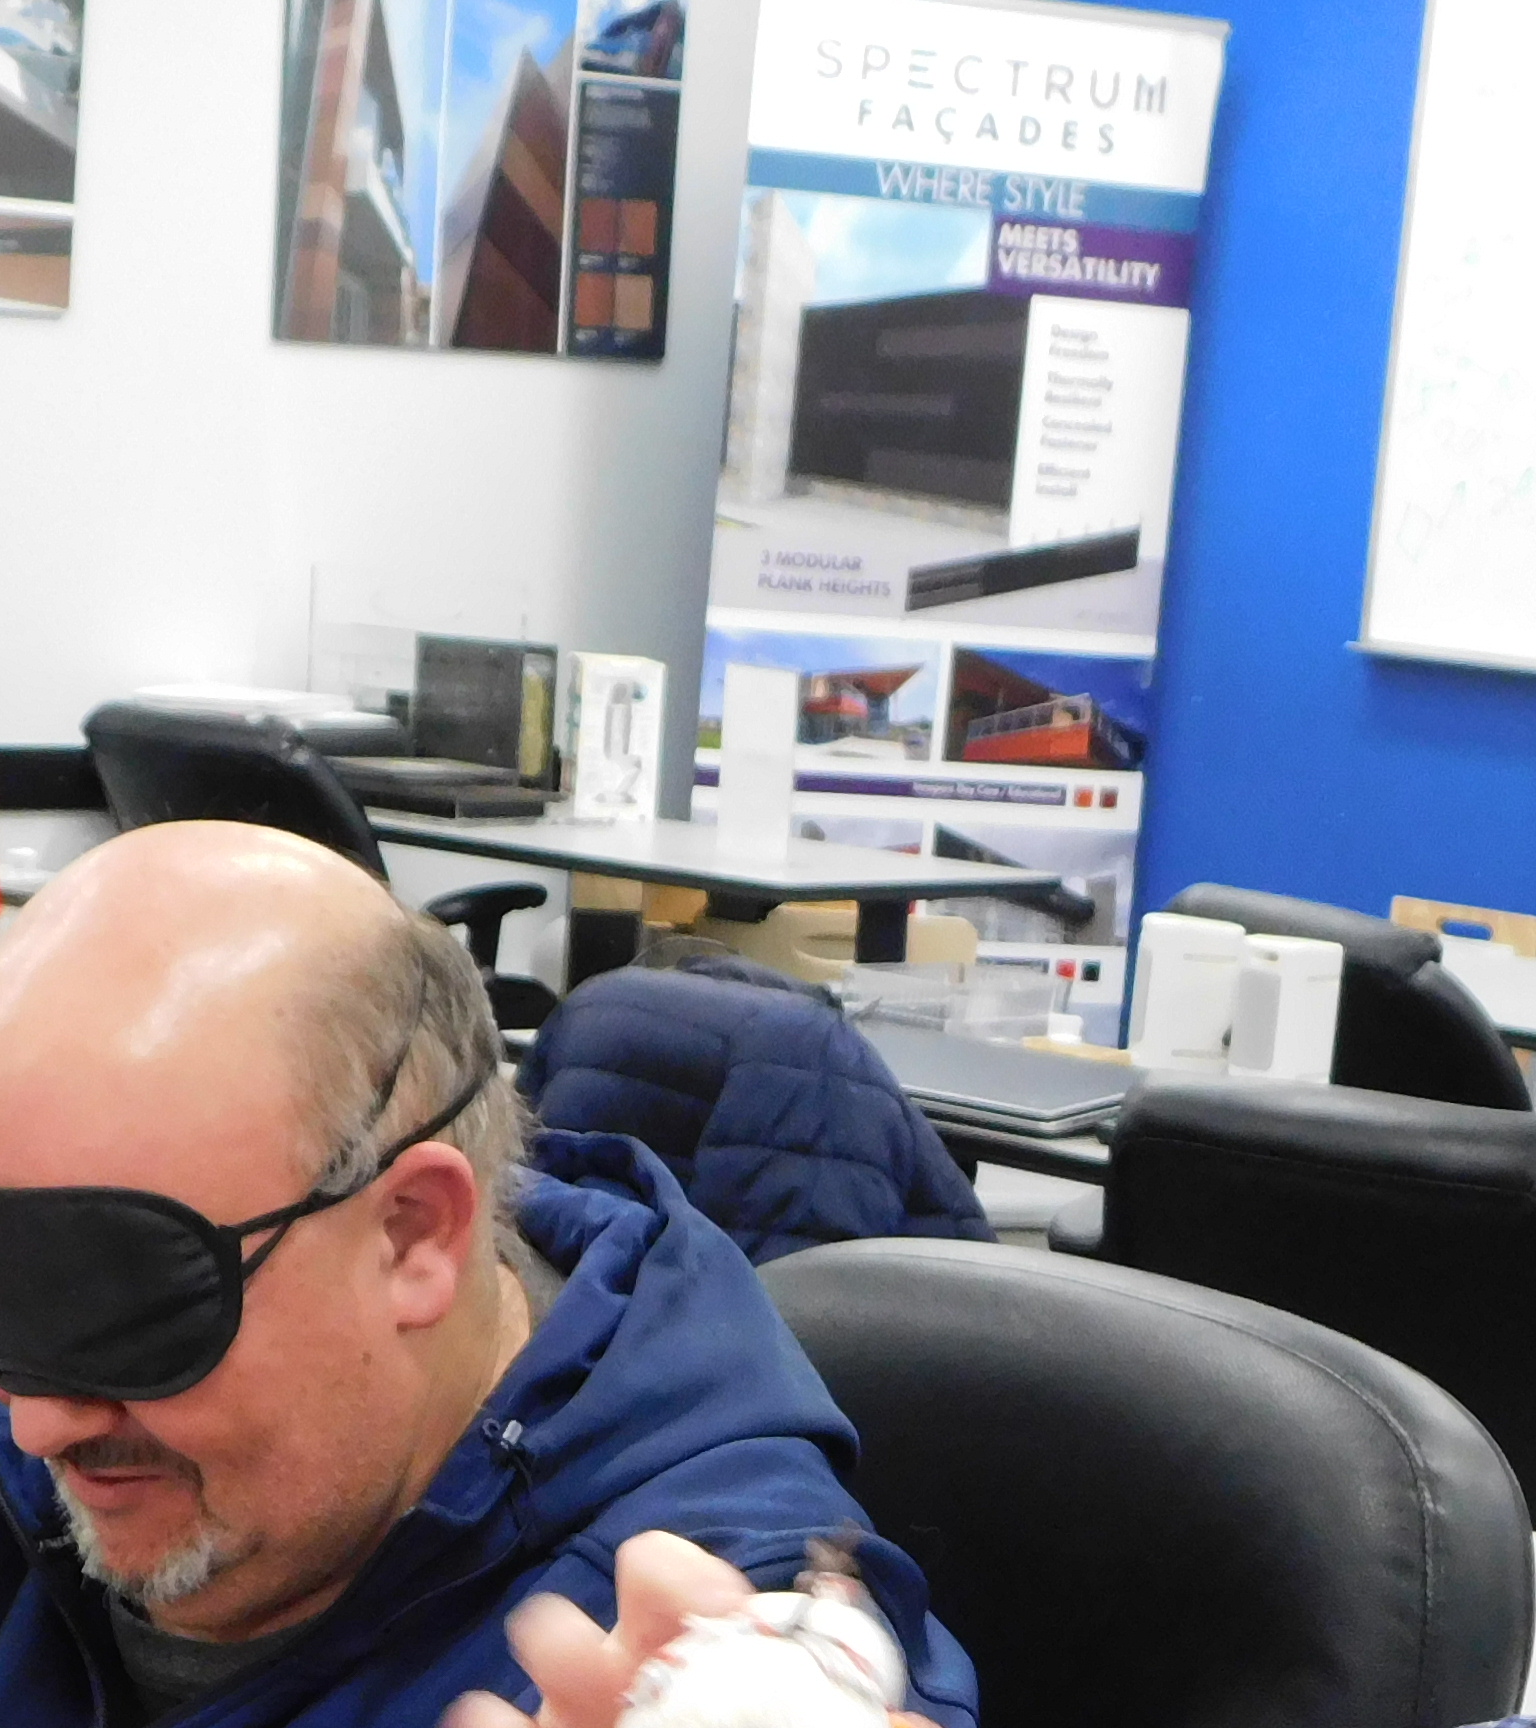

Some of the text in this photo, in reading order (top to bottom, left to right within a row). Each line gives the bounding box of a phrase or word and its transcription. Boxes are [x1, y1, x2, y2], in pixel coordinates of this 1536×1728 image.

[816, 39, 1168, 115] SPECTRUM
[857, 100, 1115, 155] FAÇADES
[876, 160, 1088, 219] WHERE STYLE
[997, 221, 1161, 291] MEETS VERSATILITY
[757, 573, 891, 598] PLANK HEIGHTS
[775, 550, 863, 571] MODULAR
